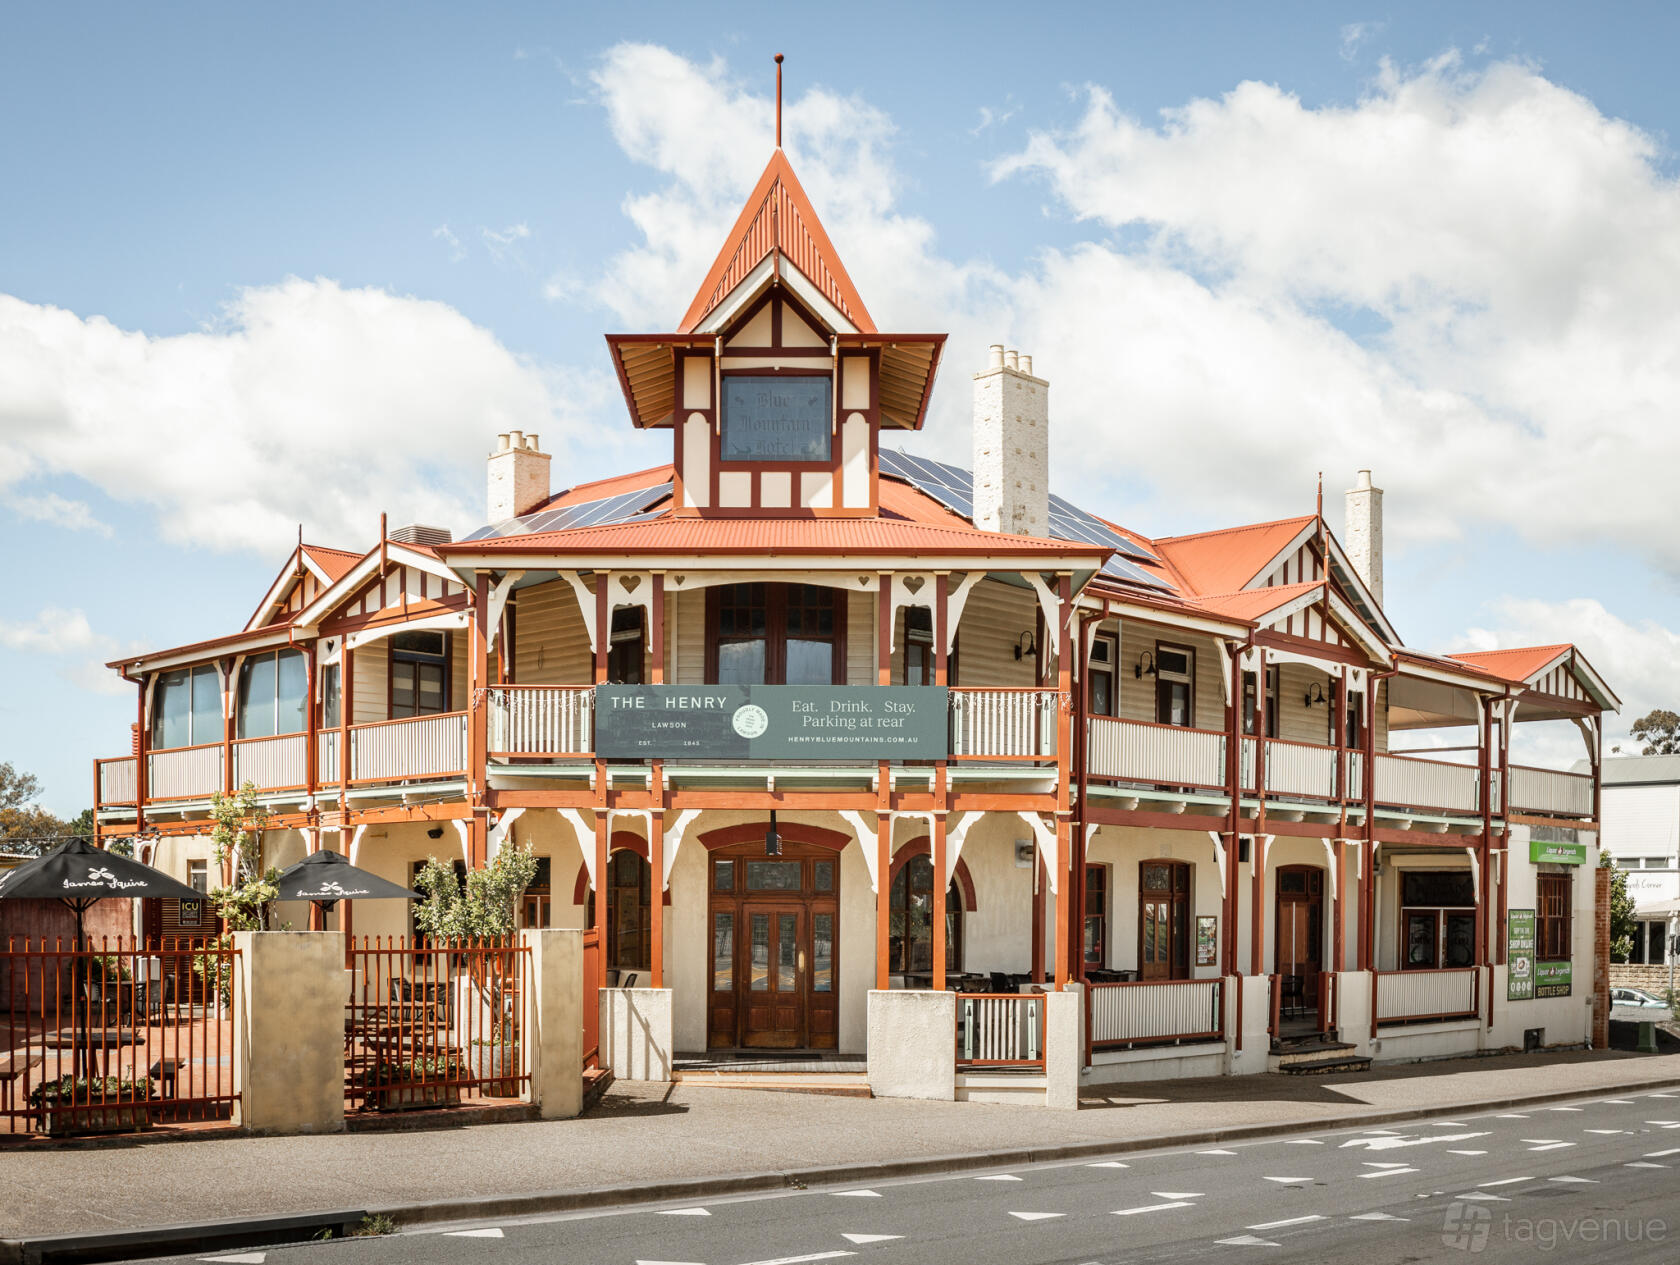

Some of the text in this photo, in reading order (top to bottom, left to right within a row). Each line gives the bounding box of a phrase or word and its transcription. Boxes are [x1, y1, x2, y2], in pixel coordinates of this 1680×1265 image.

[611, 696, 727, 709] THE HENRY
[792, 700, 916, 716] Eat. Drink. Stay.
[803, 715, 905, 731] Parking at rear
[62, 878, 149, 890] James Squire
[296, 889, 332, 897] James
[181, 902, 199, 911] ICU
[1537, 985, 1570, 997] BOTTLE SHOP
